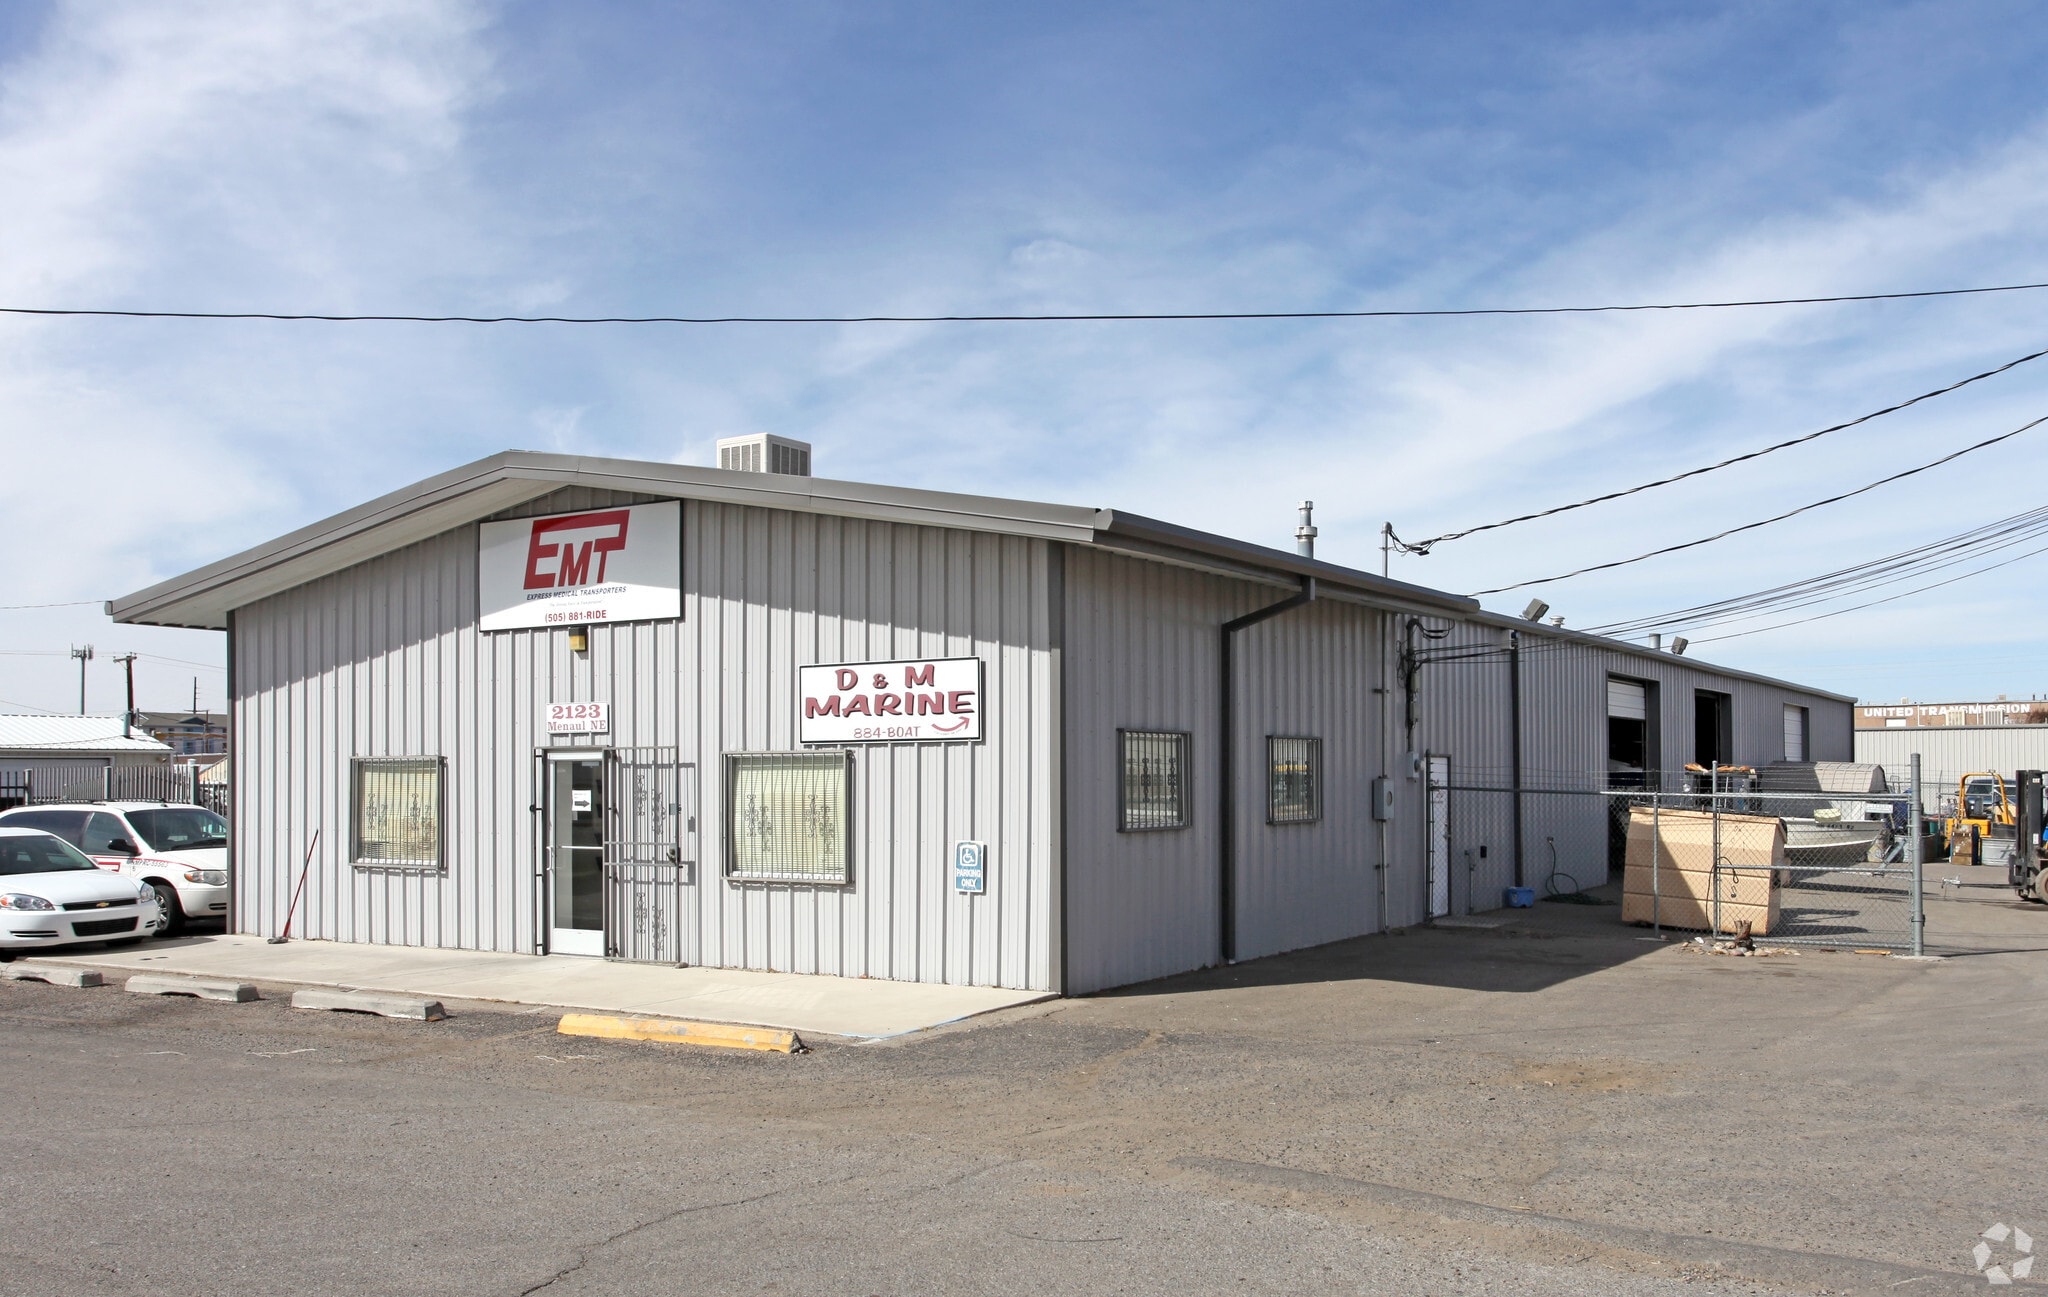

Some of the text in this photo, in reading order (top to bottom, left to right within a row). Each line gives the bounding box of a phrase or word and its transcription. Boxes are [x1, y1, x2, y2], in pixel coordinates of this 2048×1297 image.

[523, 509, 631, 590] EMT
[526, 586, 627, 600] EXPRESS MEDICAL TRANSPORTERS
[545, 609, 607, 622] (505) 881-RIDE
[835, 664, 935, 691] D & M
[552, 704, 601, 719] 2123
[805, 690, 976, 719] MARINE
[1864, 707, 1914, 717] UNITED
[547, 720, 606, 731] Menaul NE
[853, 725, 921, 739] 884-BOAT
